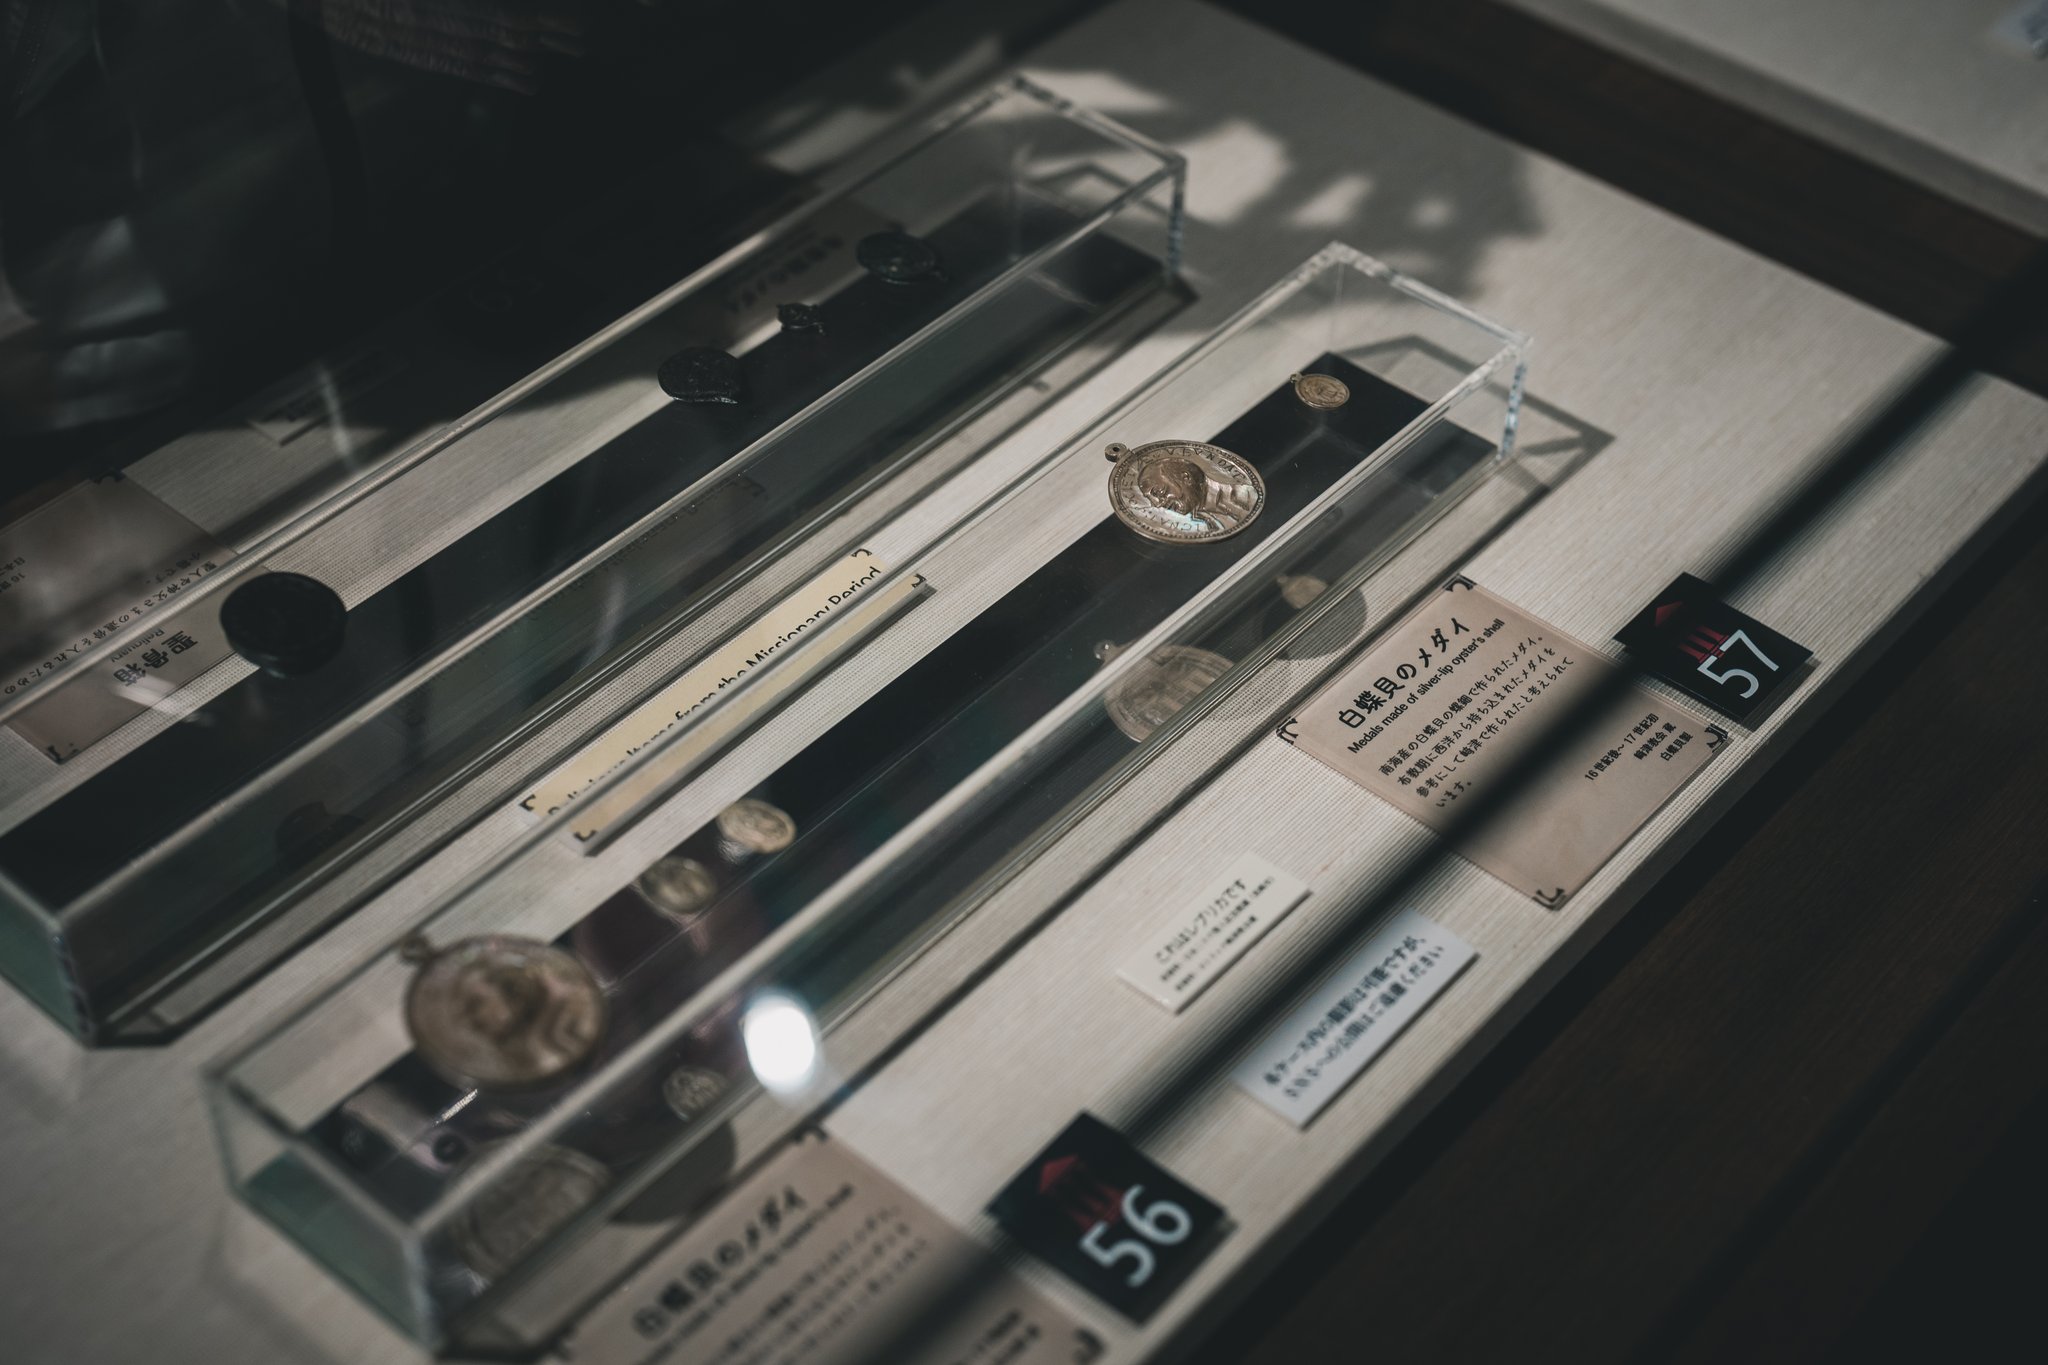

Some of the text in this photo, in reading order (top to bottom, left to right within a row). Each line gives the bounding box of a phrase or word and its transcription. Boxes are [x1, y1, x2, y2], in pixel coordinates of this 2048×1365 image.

[1338, 617, 1470, 729] 白蝶貝のメダイ
[1348, 618, 1505, 753] Medals made of silver-lip oyster's shell
[1697, 629, 1779, 699] 57
[1156, 879, 1245, 962] これはレプリカです
[1080, 1183, 1192, 1288] 56
